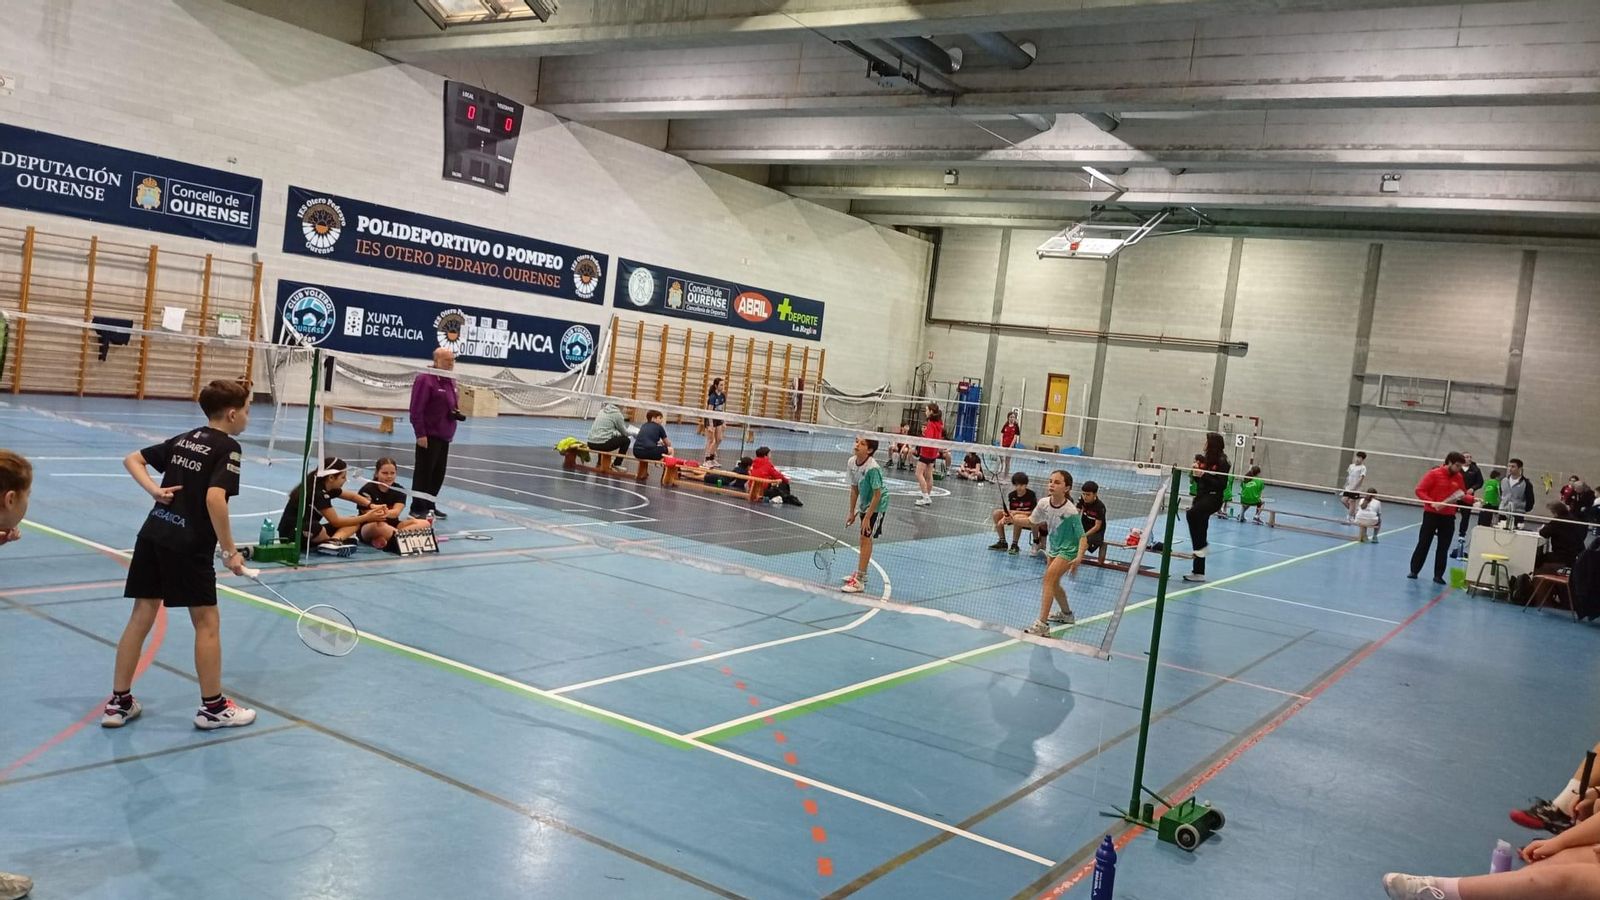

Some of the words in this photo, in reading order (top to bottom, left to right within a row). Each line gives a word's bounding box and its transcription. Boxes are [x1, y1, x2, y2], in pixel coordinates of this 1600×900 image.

[467, 106, 476, 120] 0
[505, 118, 513, 131] 0
[0, 151, 122, 187] DEPUTACIÓN
[16, 173, 105, 201] OURENSE
[171, 184, 223, 204] Concello
[225, 195, 240, 208] de
[170, 198, 250, 225] OURENSE
[297, 204, 309, 218] IES
[306, 198, 327, 208] Otero
[327, 198, 347, 227] Pedrayo
[305, 242, 335, 255] Ourense
[356, 215, 491, 256] POLIDEPORTIVO
[492, 243, 504, 259] O
[506, 246, 564, 271] POMPEO
[355, 239, 381, 257] IES
[384, 245, 434, 266] OTERO
[502, 266, 561, 289] OURENSE
[688, 282, 713, 296] Concello
[714, 287, 723, 298] de
[288, 290, 304, 309] CLUB
[305, 289, 333, 315] VOLEIBOL
[687, 292, 727, 309] OURENSE
[737, 296, 768, 318] ABRIL
[366, 311, 404, 327] XUNTA
[792, 323, 799, 331] La
[365, 324, 379, 337] DE
[382, 327, 424, 341] GALICIA
[508, 331, 554, 354] ANCA
[1236, 435, 1244, 446] 3
[171, 454, 202, 472] ATHLOS
[425, 537, 434, 549] 4
